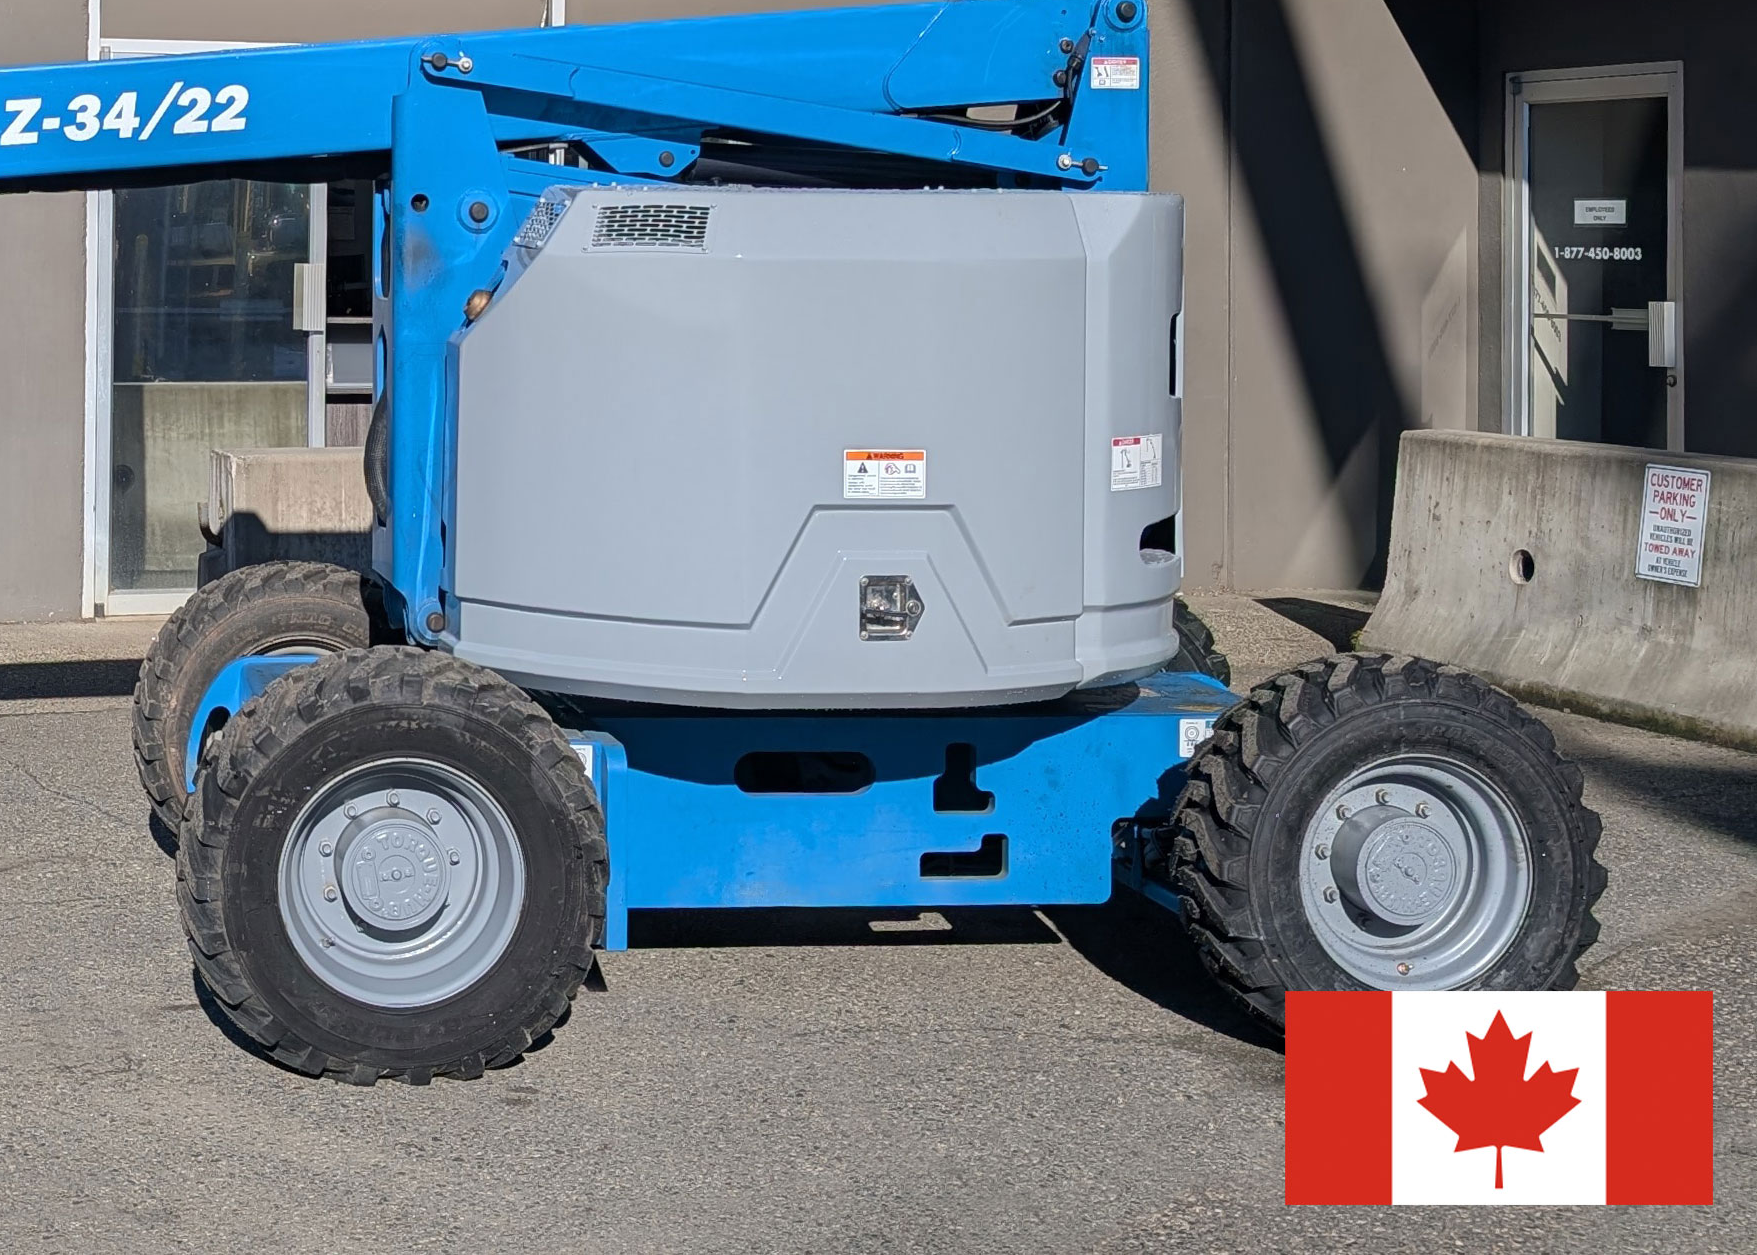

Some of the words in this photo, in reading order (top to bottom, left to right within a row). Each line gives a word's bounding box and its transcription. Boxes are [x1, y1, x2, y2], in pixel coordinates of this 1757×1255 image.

[0, 81, 249, 146] Z-34/22
[1554, 246, 1642, 261] 1-877-450-8003
[1650, 473, 1703, 492] CUSTOMER
[1653, 490, 1696, 508] PARKING
[1649, 532, 1673, 543] VEHICLES
[1652, 524, 1692, 537] UNAUTHORIZED
[1644, 541, 1670, 555] TOWED
[1672, 547, 1696, 559] AWAY
